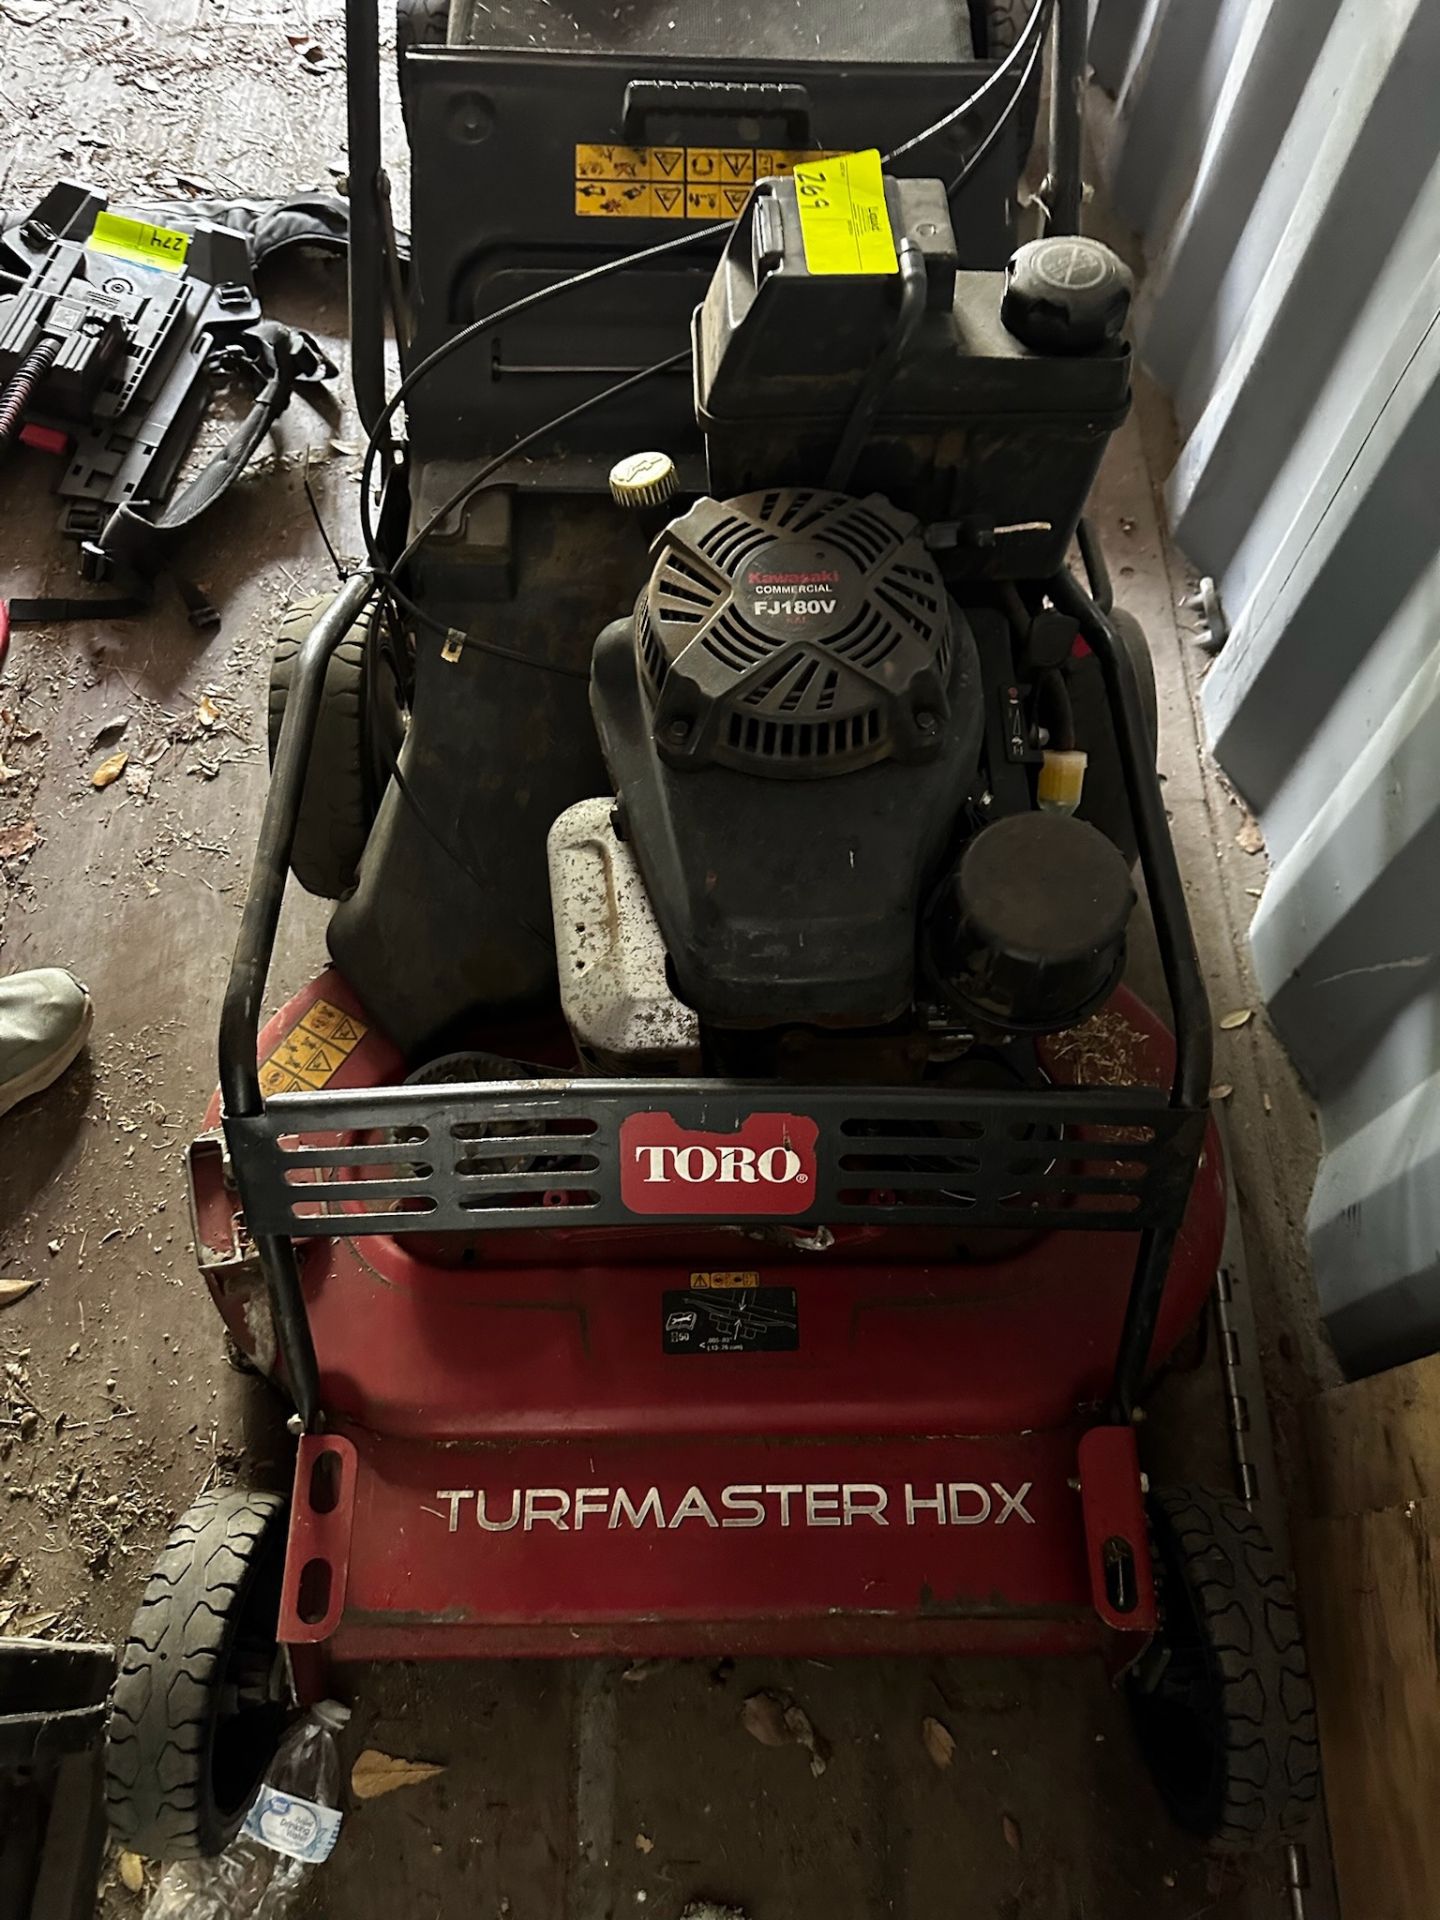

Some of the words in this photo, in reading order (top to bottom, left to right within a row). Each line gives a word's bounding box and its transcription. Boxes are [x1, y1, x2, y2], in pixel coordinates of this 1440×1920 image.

[797, 172, 830, 210] 269
[150, 229, 184, 251] 274
[748, 570, 839, 584] Kawasaki
[755, 584, 833, 594] COMMERCIAL
[754, 600, 837, 615] FJ180V
[635, 1146, 802, 1183] TORO
[436, 1483, 890, 1532] TURFMASTER
[905, 1482, 1036, 1526] HDX
